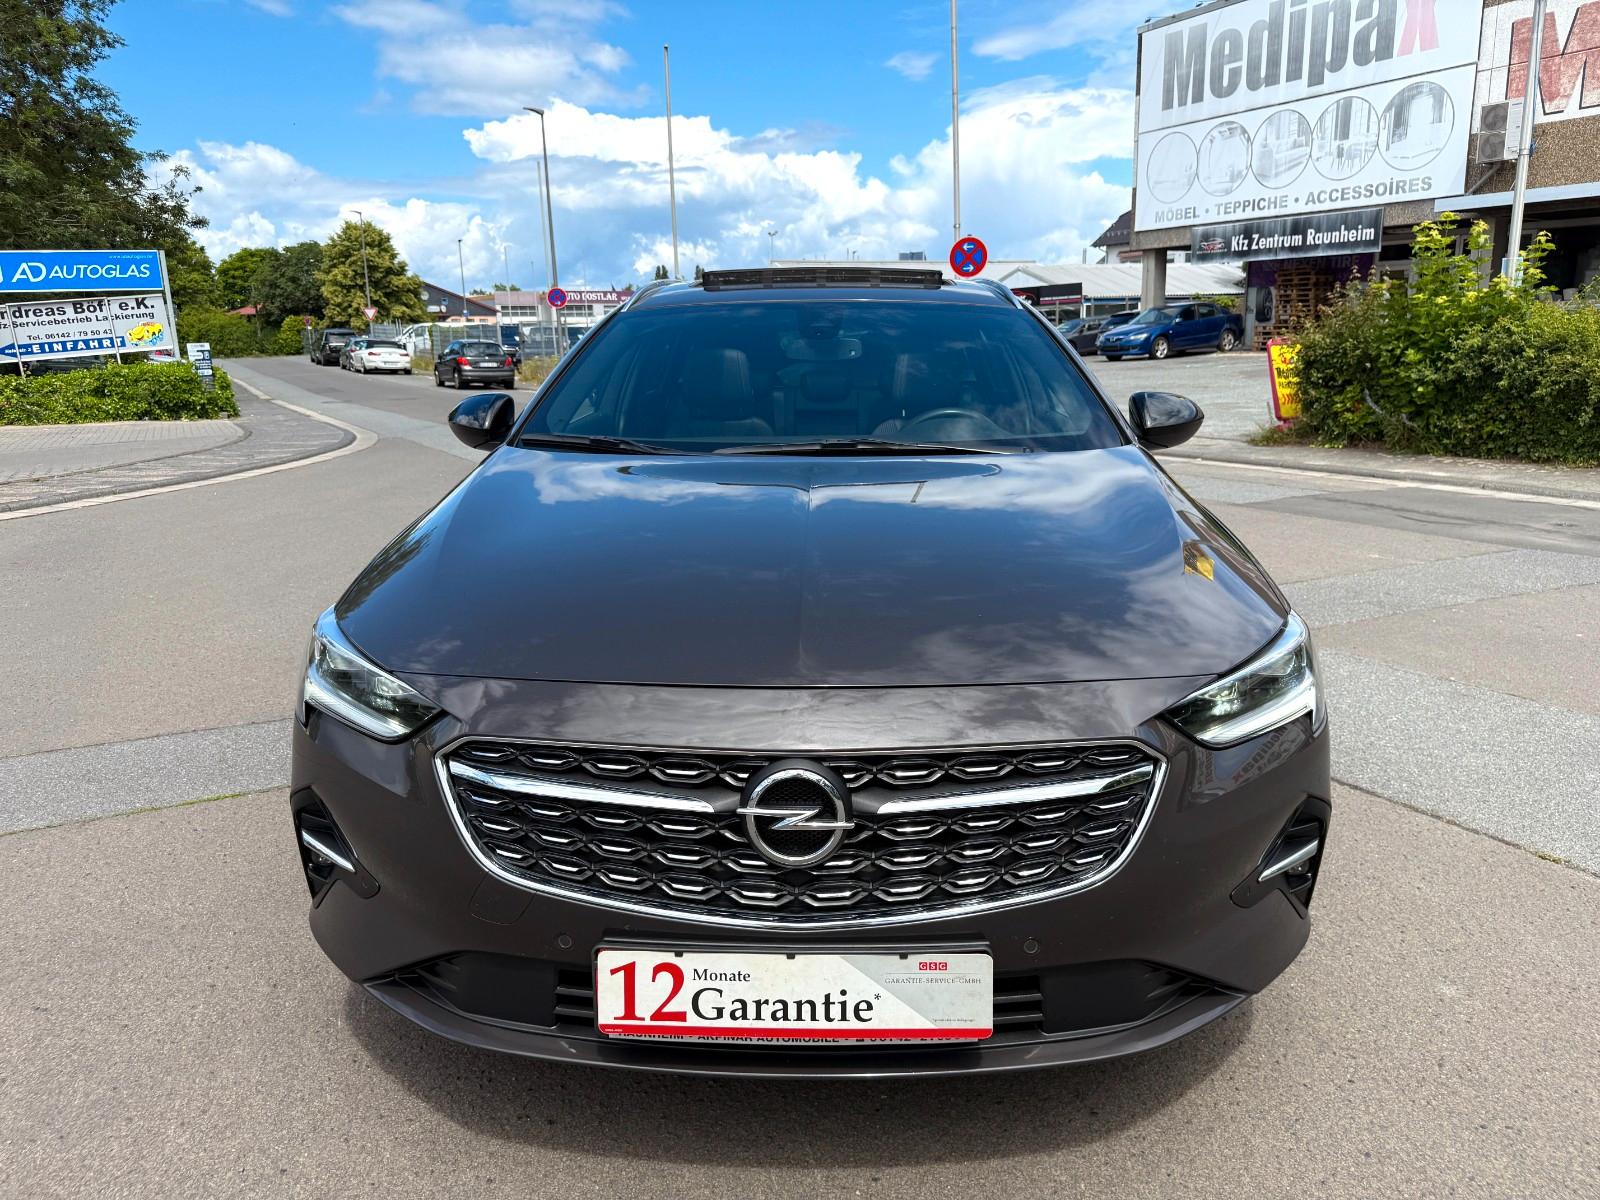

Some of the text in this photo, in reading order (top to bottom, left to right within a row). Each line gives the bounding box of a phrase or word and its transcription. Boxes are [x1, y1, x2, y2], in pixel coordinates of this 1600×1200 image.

[1161, 0, 1440, 112] Medipax
[1154, 206, 1200, 224] MÖBEL
[1214, 195, 1288, 216] TEPPICHE
[1231, 225, 1375, 252] Kfz Zentrum Raunheim
[12, 262, 150, 282] AD AUTOGLAS
[119, 297, 155, 311] e.K.
[45, 331, 71, 339] 06142
[32, 336, 123, 353] EINFAHRT
[692, 968, 751, 982] Monate
[919, 962, 947, 970] GSG
[610, 961, 687, 1022] 12
